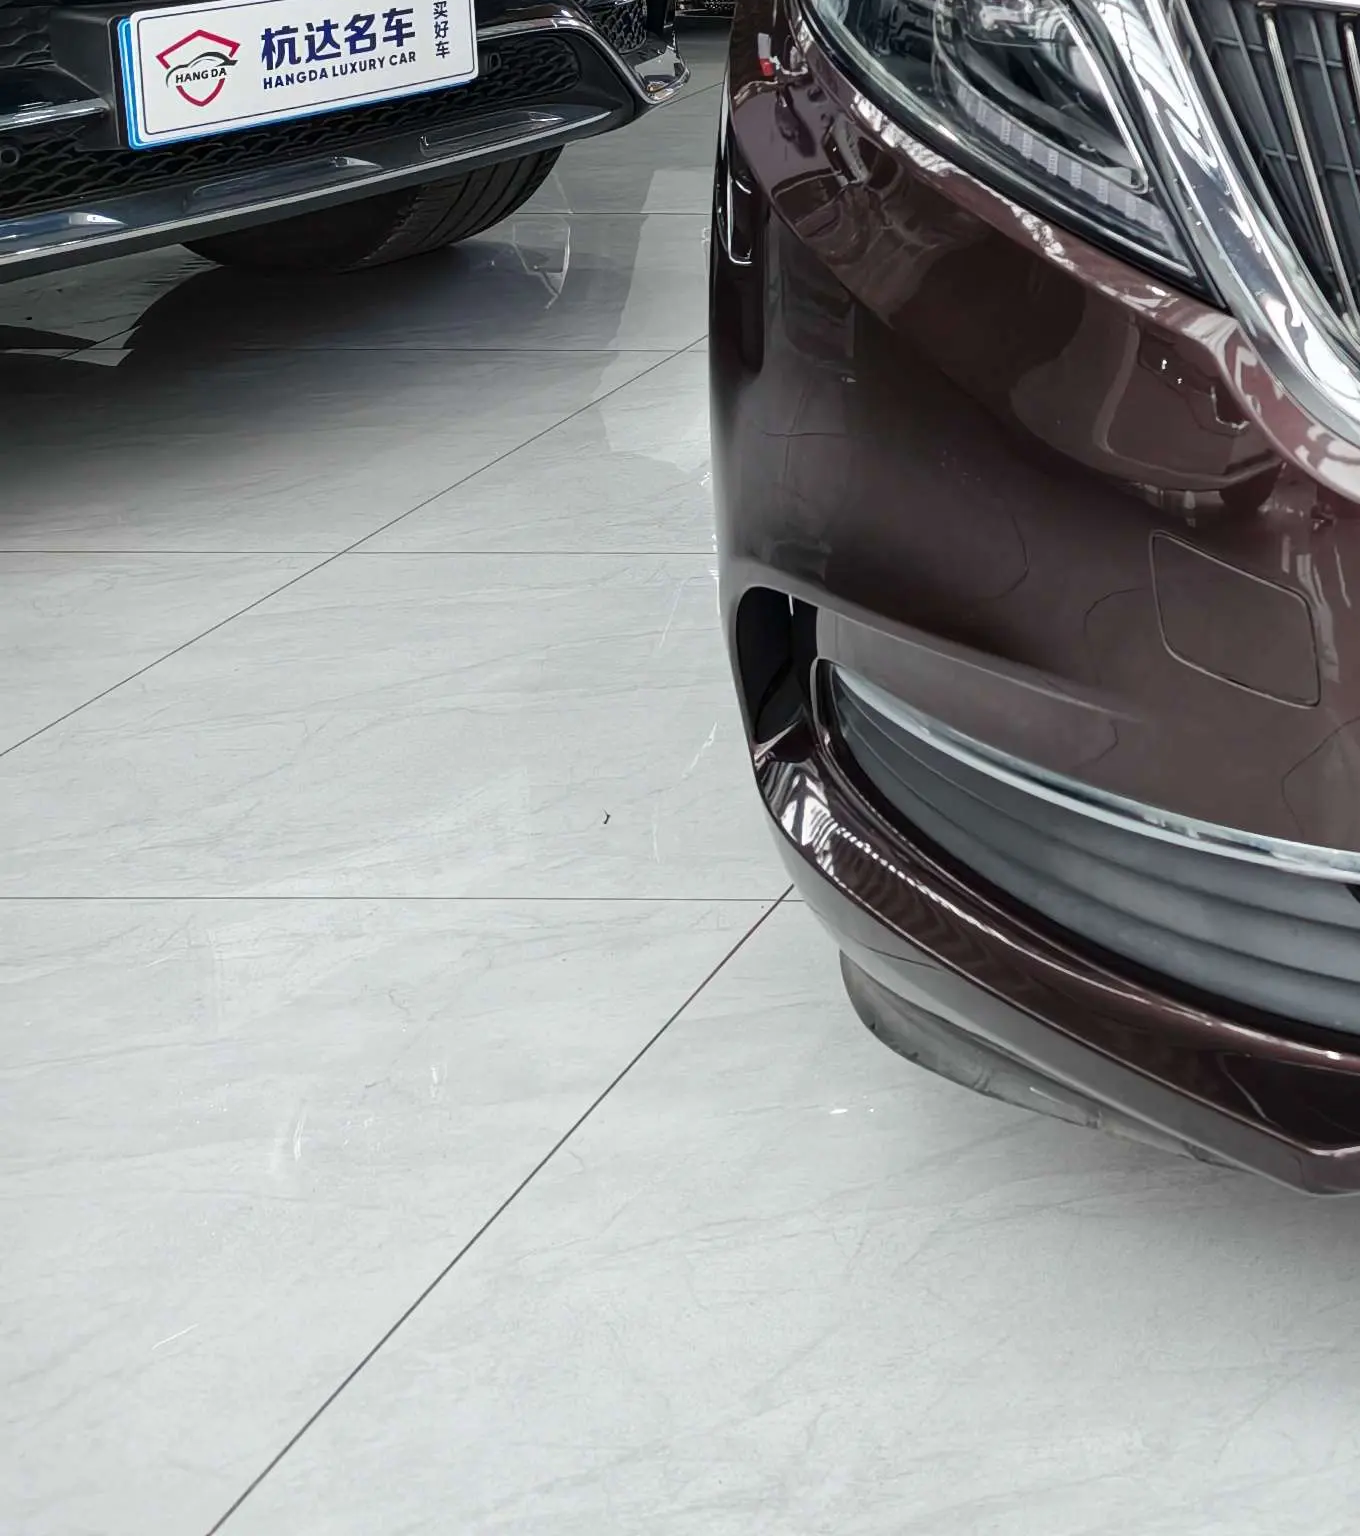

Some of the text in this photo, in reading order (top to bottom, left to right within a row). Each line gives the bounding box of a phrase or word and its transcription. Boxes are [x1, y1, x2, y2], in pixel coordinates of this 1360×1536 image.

[260, 7, 416, 71] 杭达名车
[432, 0, 451, 59] 买好车
[175, 67, 227, 84] HANG DA
[262, 51, 417, 90] HANGDA LUXURY CAR
